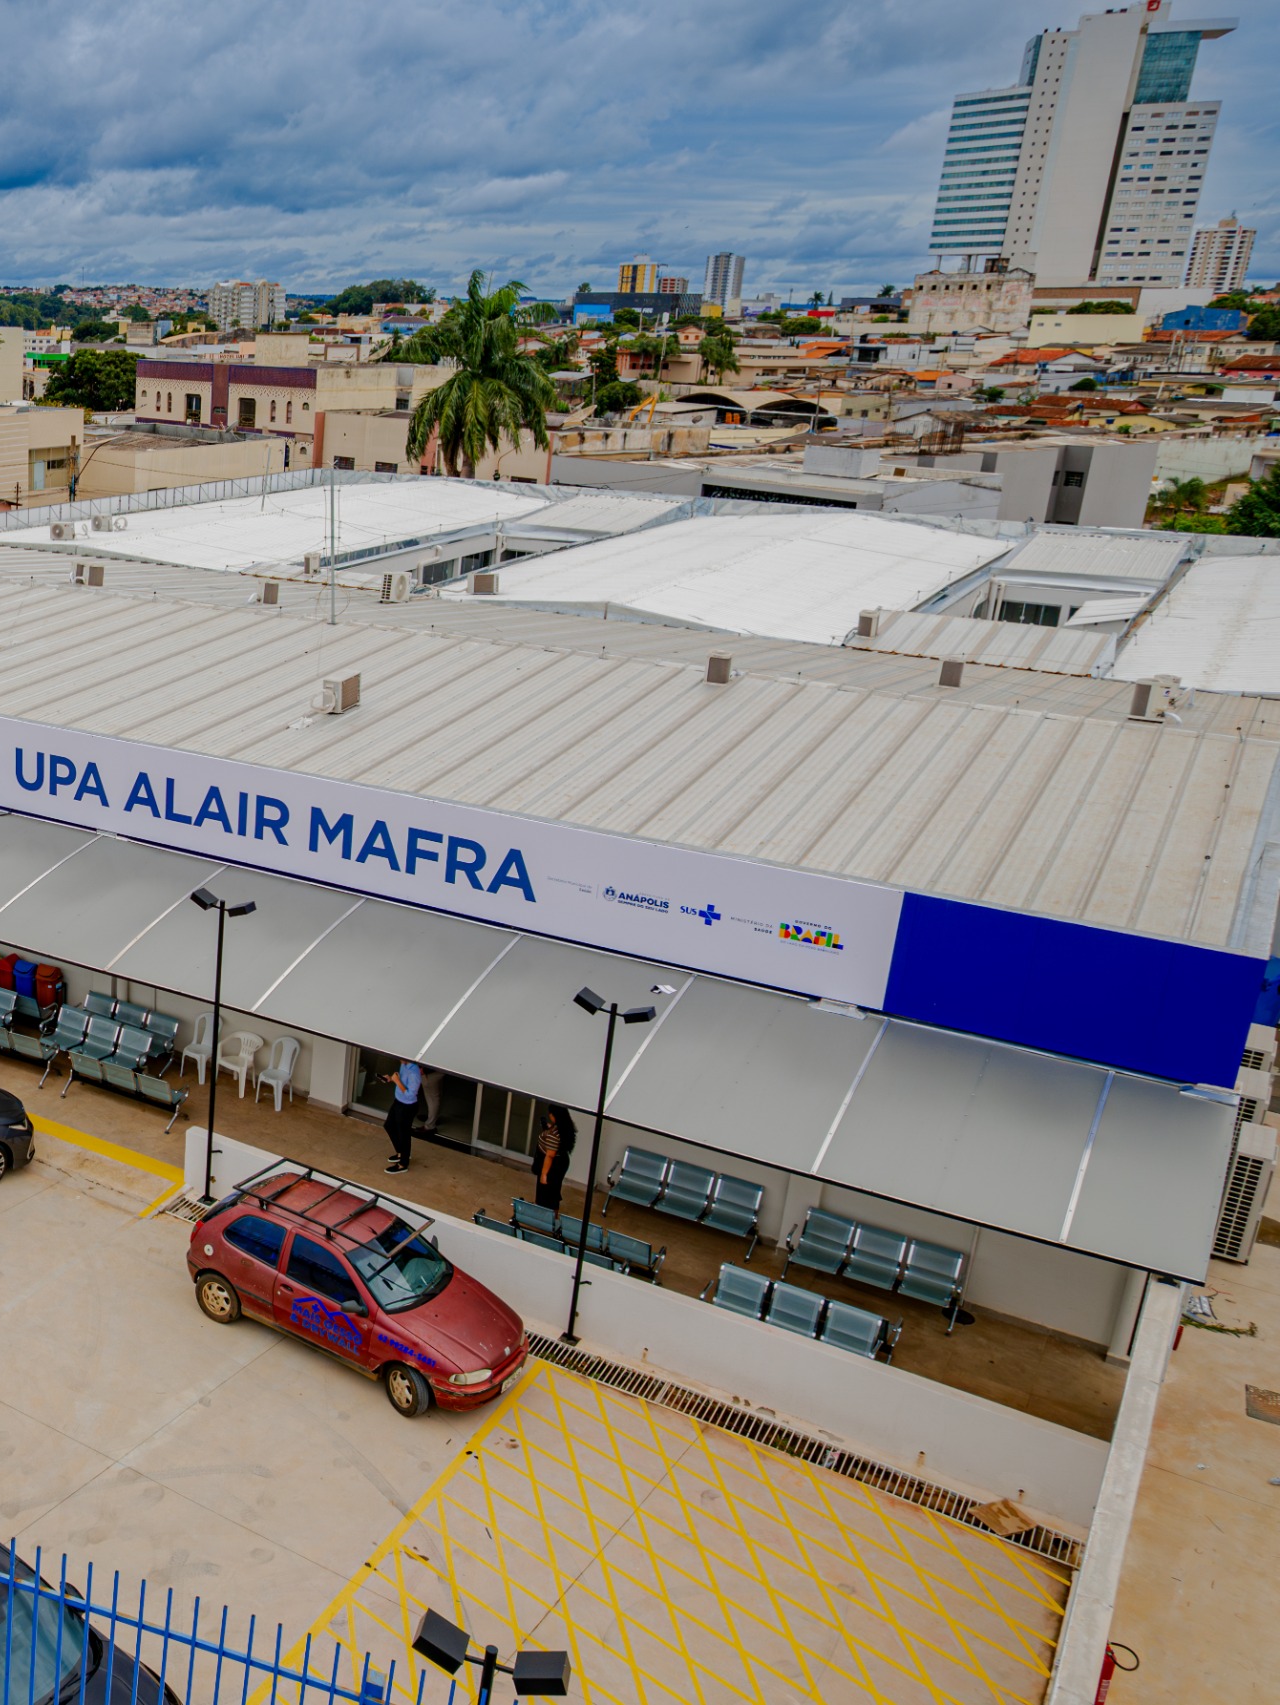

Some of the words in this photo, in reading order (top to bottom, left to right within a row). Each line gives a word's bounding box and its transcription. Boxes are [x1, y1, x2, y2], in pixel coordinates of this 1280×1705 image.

[15, 747, 110, 808] UPA
[123, 771, 290, 847] ALAIR
[308, 805, 537, 903] MAFRA
[680, 905, 697, 916] SUS
[794, 919, 822, 928] GOVERNO
[778, 922, 844, 951] BRASIL
[290, 1312, 299, 1324] &
[301, 1318, 361, 1356] DRYWALL
[324, 1319, 363, 1346] GESSO
[377, 1333, 388, 1343] 62
